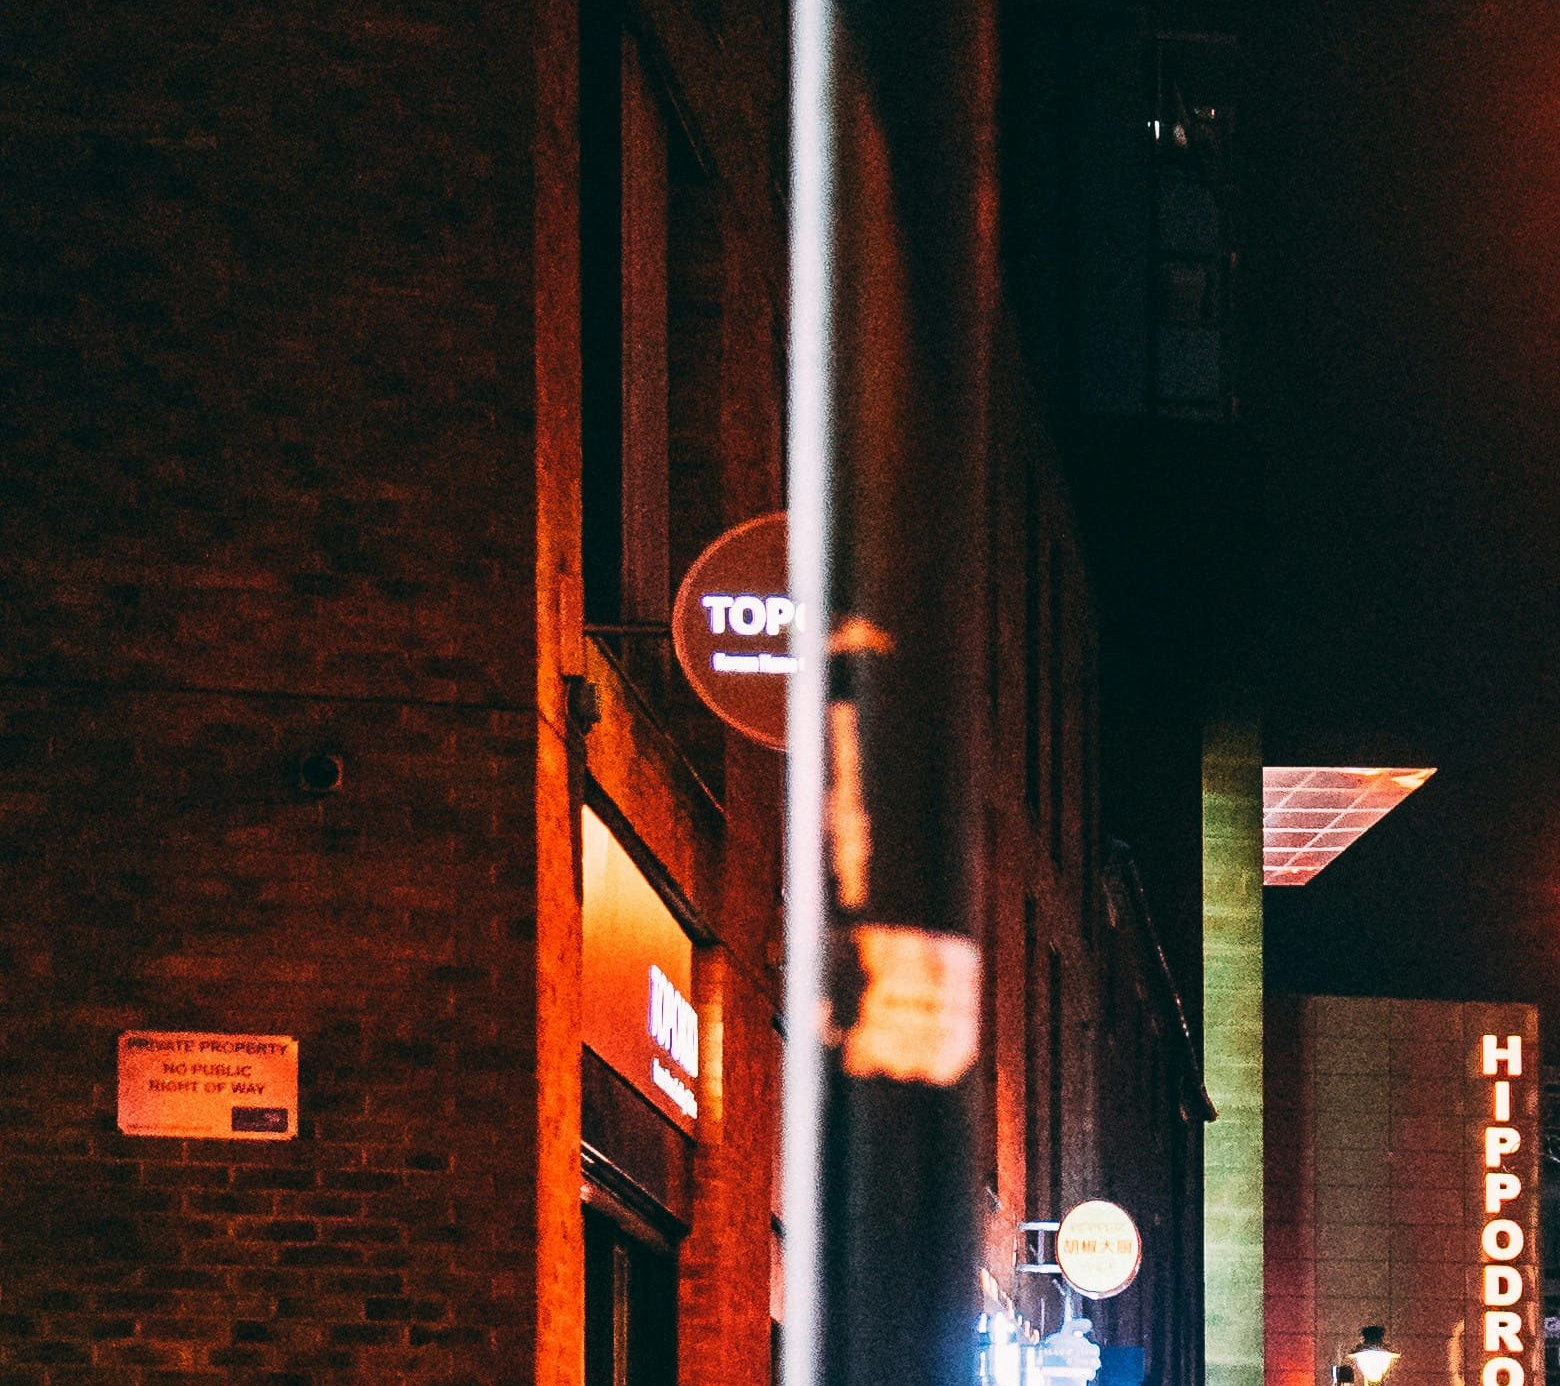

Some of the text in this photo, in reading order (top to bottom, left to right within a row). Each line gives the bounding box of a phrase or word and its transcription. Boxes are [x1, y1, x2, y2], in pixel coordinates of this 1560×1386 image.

[701, 595, 805, 636] TOP
[200, 1041, 287, 1055] PROPERTY
[163, 1063, 251, 1077] NO PUBLIC
[149, 1079, 264, 1094] RIGHT OF WAY
